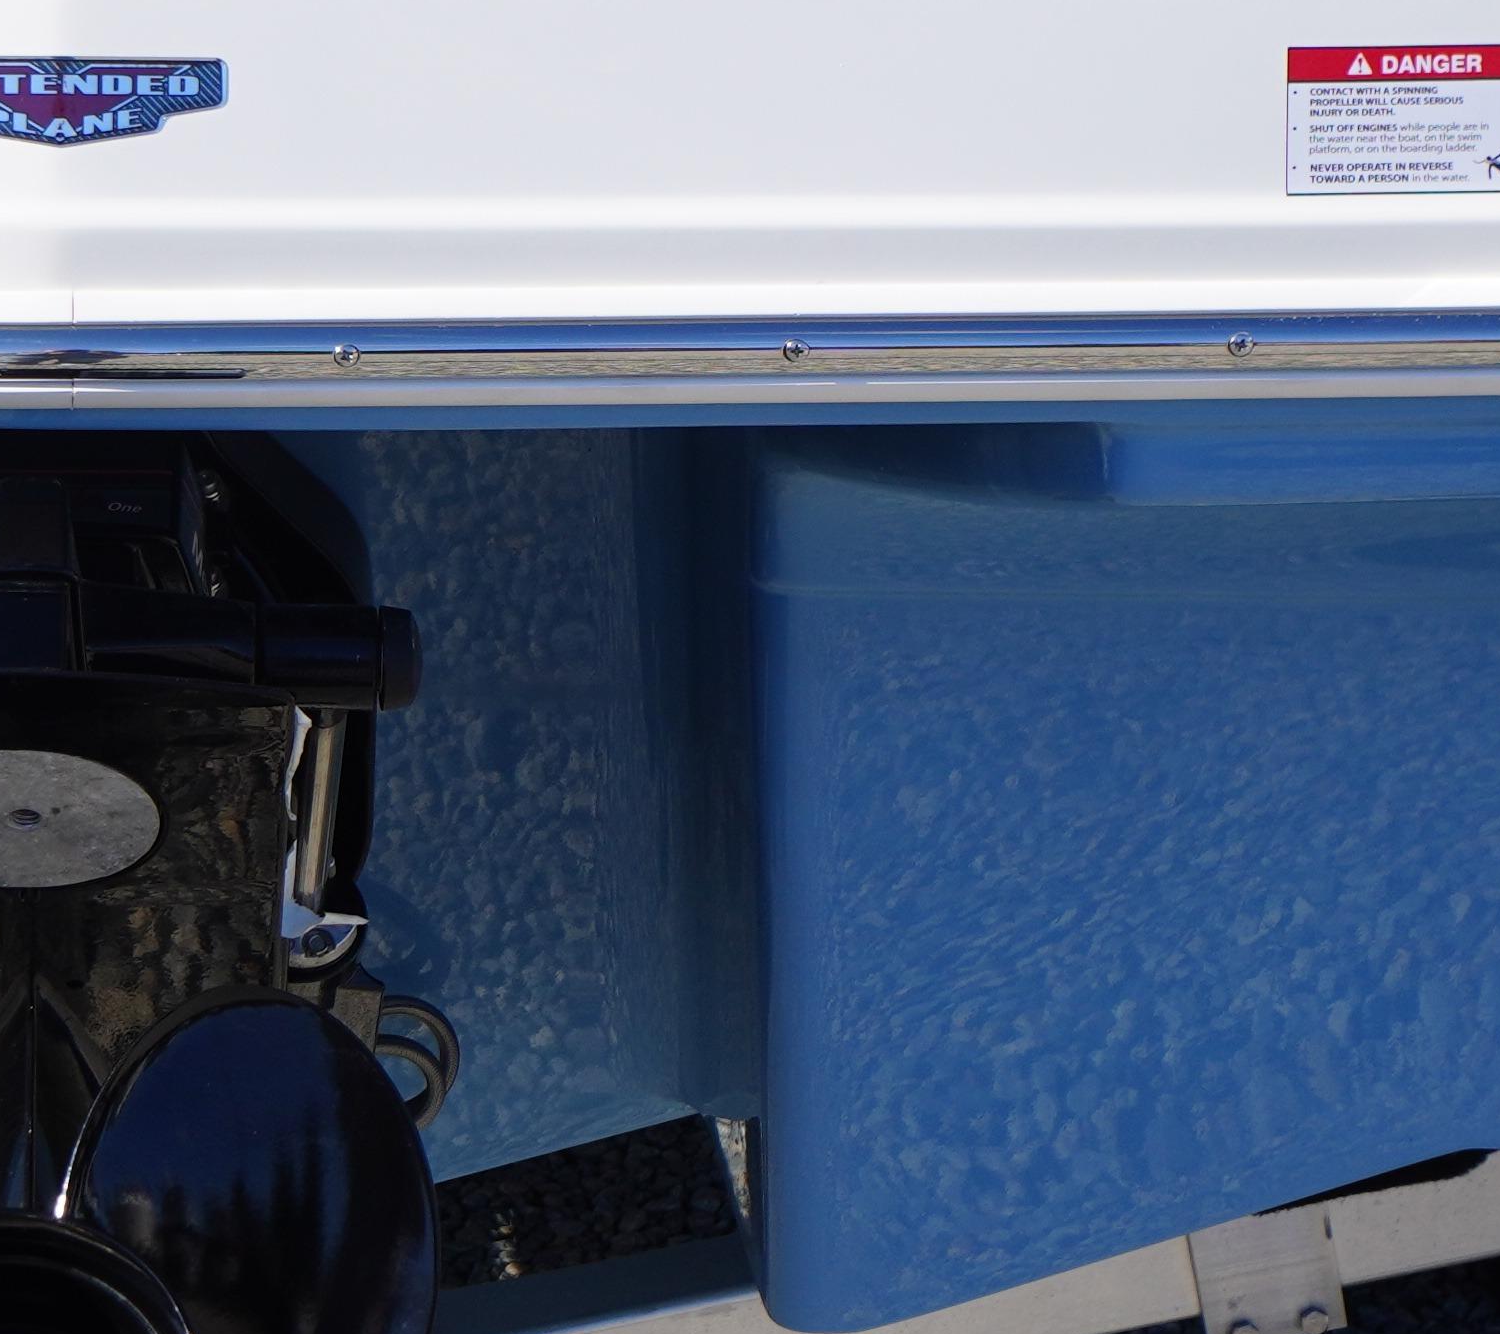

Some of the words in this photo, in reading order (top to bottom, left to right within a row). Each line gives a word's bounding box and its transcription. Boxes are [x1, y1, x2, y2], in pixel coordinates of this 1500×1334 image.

[1382, 54, 1482, 74] DANGER
[1310, 88, 1353, 96] CONTACT
[1356, 87, 1381, 95] WITH
[1392, 87, 1438, 95] SPINNING
[1310, 98, 1364, 106] PROPELLER
[1366, 98, 1388, 106] WILL
[1390, 97, 1421, 105] CAUSE
[1424, 97, 1464, 105] SERIOUS
[1310, 109, 1343, 117] INJURY
[1361, 108, 1396, 116] DEATH.
[1310, 125, 1334, 133] SHUT
[1336, 124, 1354, 132] OFF
[1357, 124, 1398, 132] ENGINES
[1400, 123, 1426, 131] while
[1428, 122, 1460, 133] people
[1463, 123, 1478, 131] are
[1480, 122, 1490, 130] in
[1309, 135, 1325, 143] the
[1327, 135, 1354, 143] water
[1380, 134, 1396, 142] the
[1398, 134, 1422, 143] boat,
[1439, 133, 1455, 141] the
[1457, 133, 1482, 141] swim
[1309, 145, 1352, 155] platform,
[1382, 145, 1398, 153] the
[1400, 144, 1443, 155] boarding
[1446, 143, 1477, 152] ladder.
[1310, 164, 1344, 172] NEVER
[1346, 163, 1392, 171] OPERATE
[1395, 163, 1406, 171] IN
[1408, 162, 1453, 170] REVERSE
[1310, 175, 1356, 184] TOWARD
[1358, 175, 1366, 183] A
[1368, 174, 1409, 183] PERSON
[1412, 174, 1420, 182] in
[1423, 173, 1439, 182] the
[1441, 174, 1470, 182] water.
[108, 502, 142, 513] One
